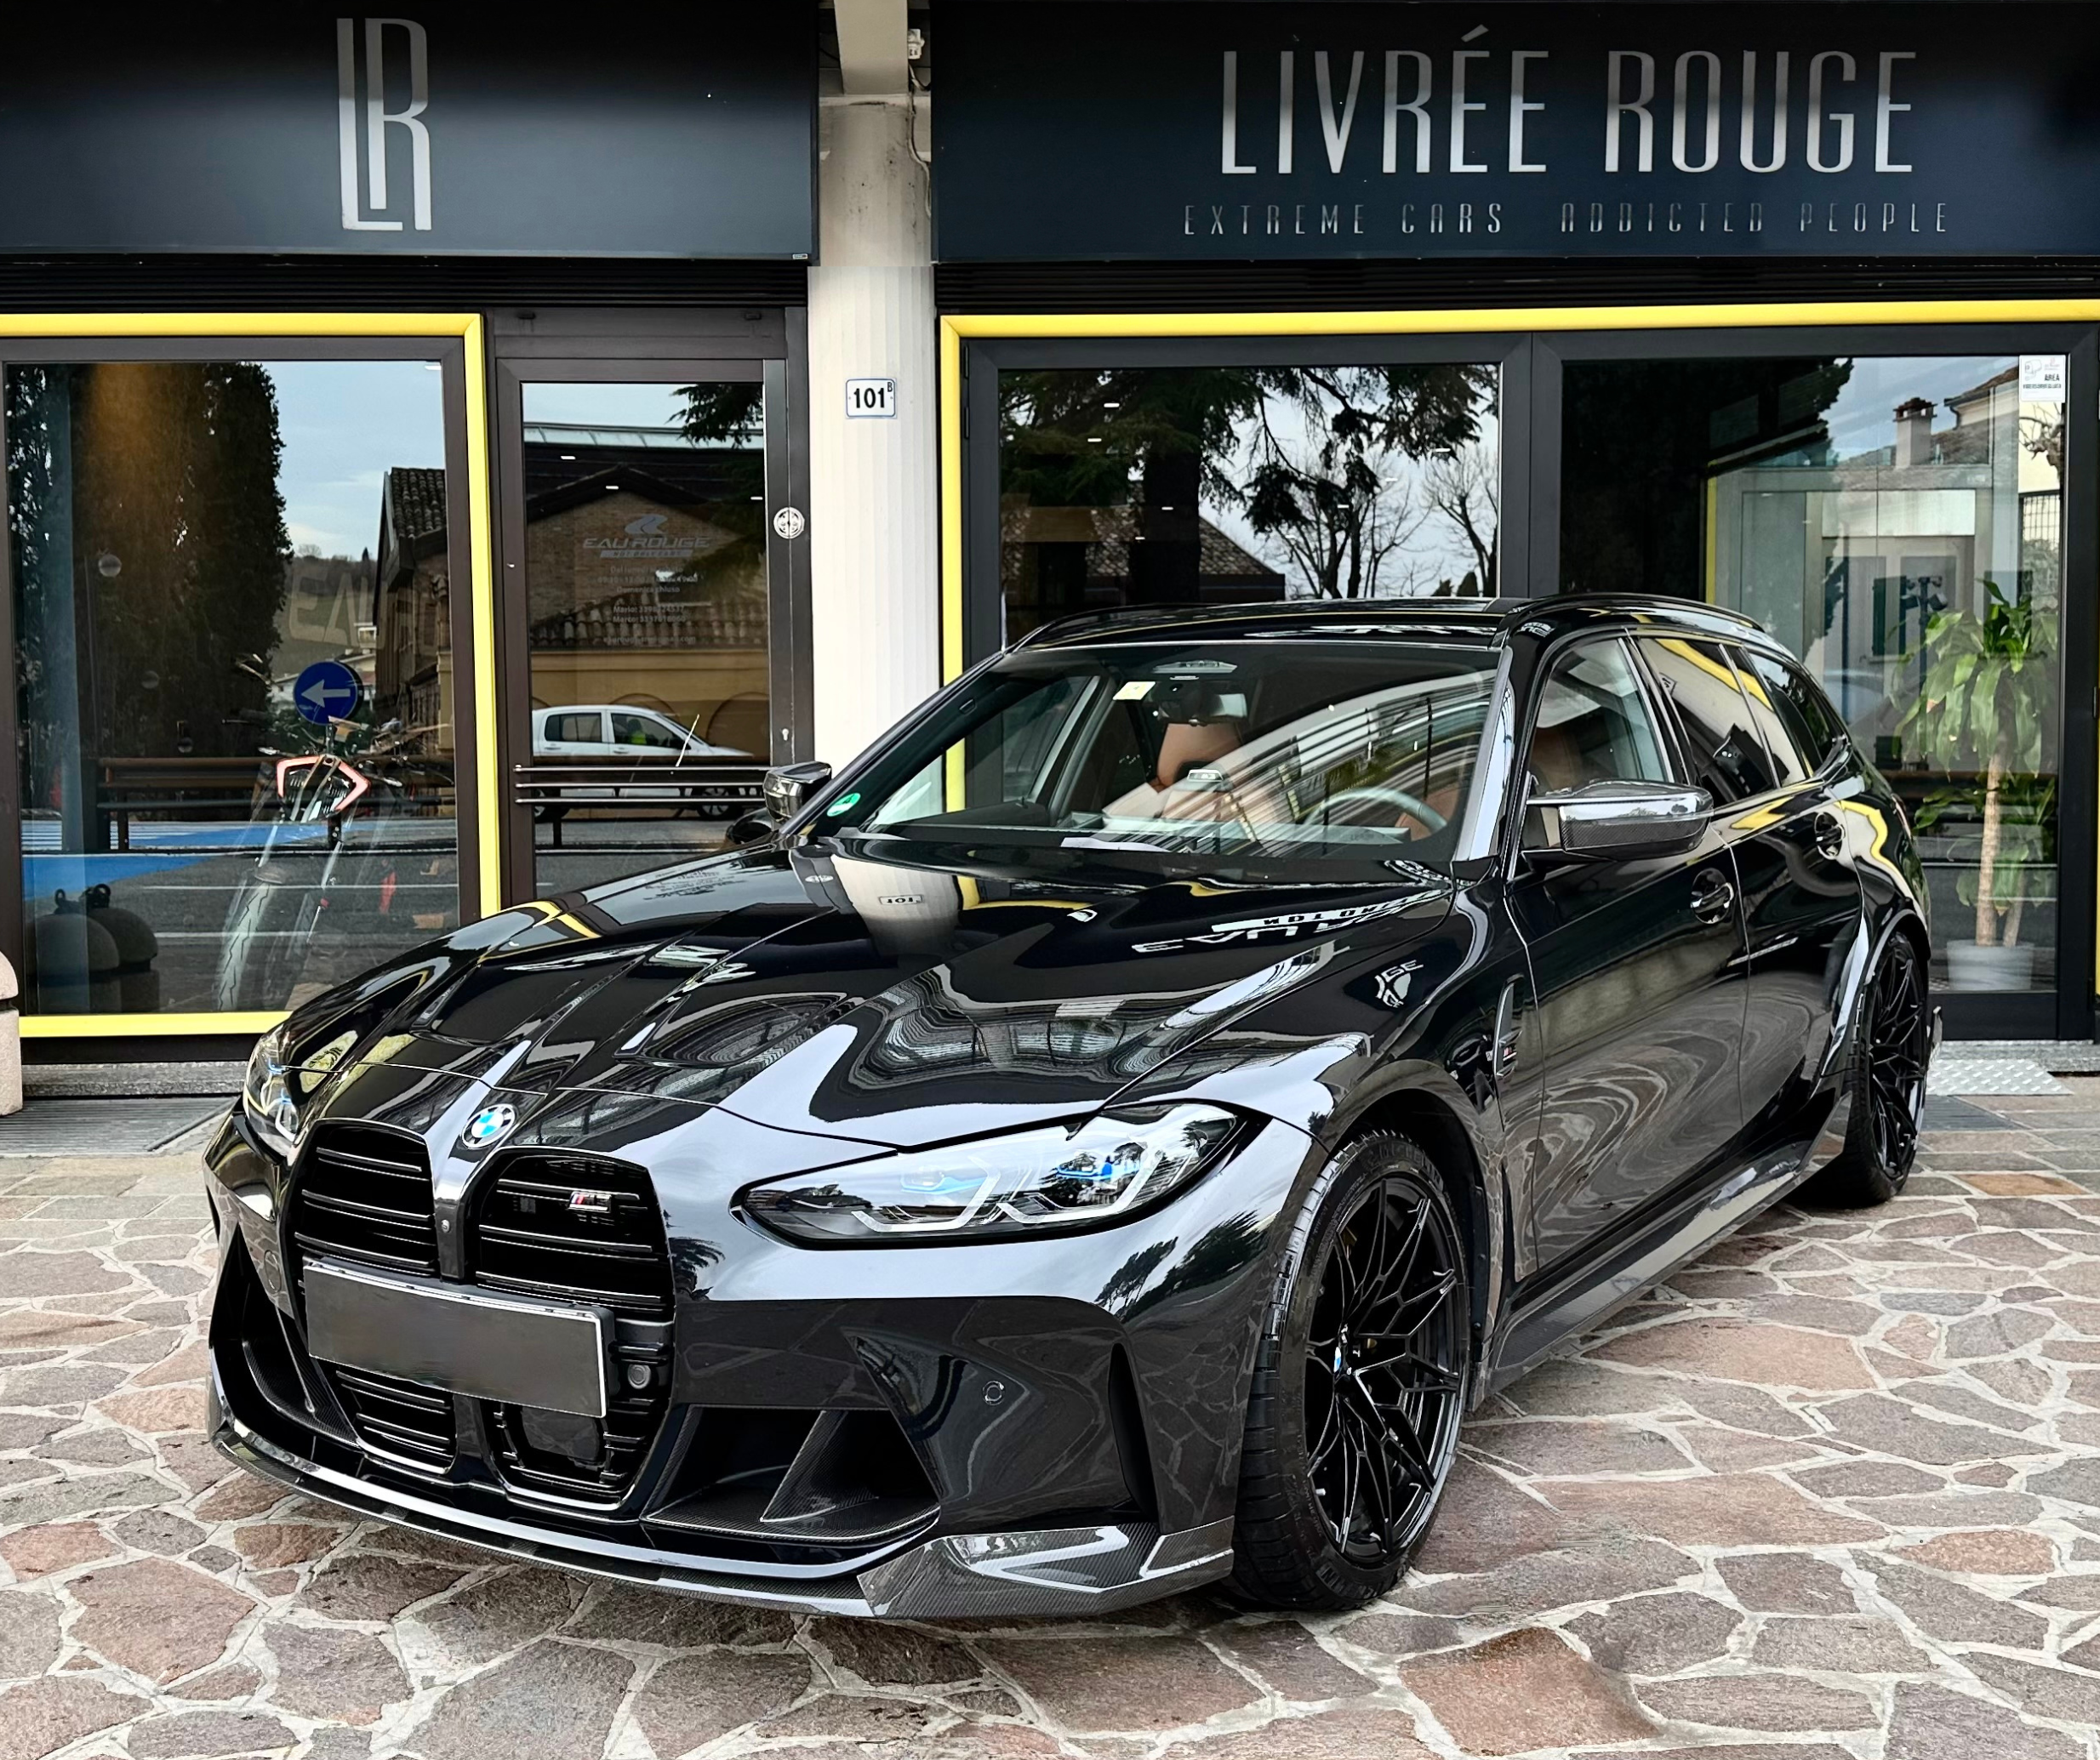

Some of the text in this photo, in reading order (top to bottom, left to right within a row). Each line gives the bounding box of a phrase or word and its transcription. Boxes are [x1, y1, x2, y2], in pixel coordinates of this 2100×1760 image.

[1220, 24, 1917, 174] LIVRÉE ROUGE
[336, 17, 432, 231] LR
[1184, 202, 1947, 235] EXTREME CARS ADDICTED PEOPLE
[853, 388, 885, 408] 101
[582, 537, 710, 549] EAU ROUGE
